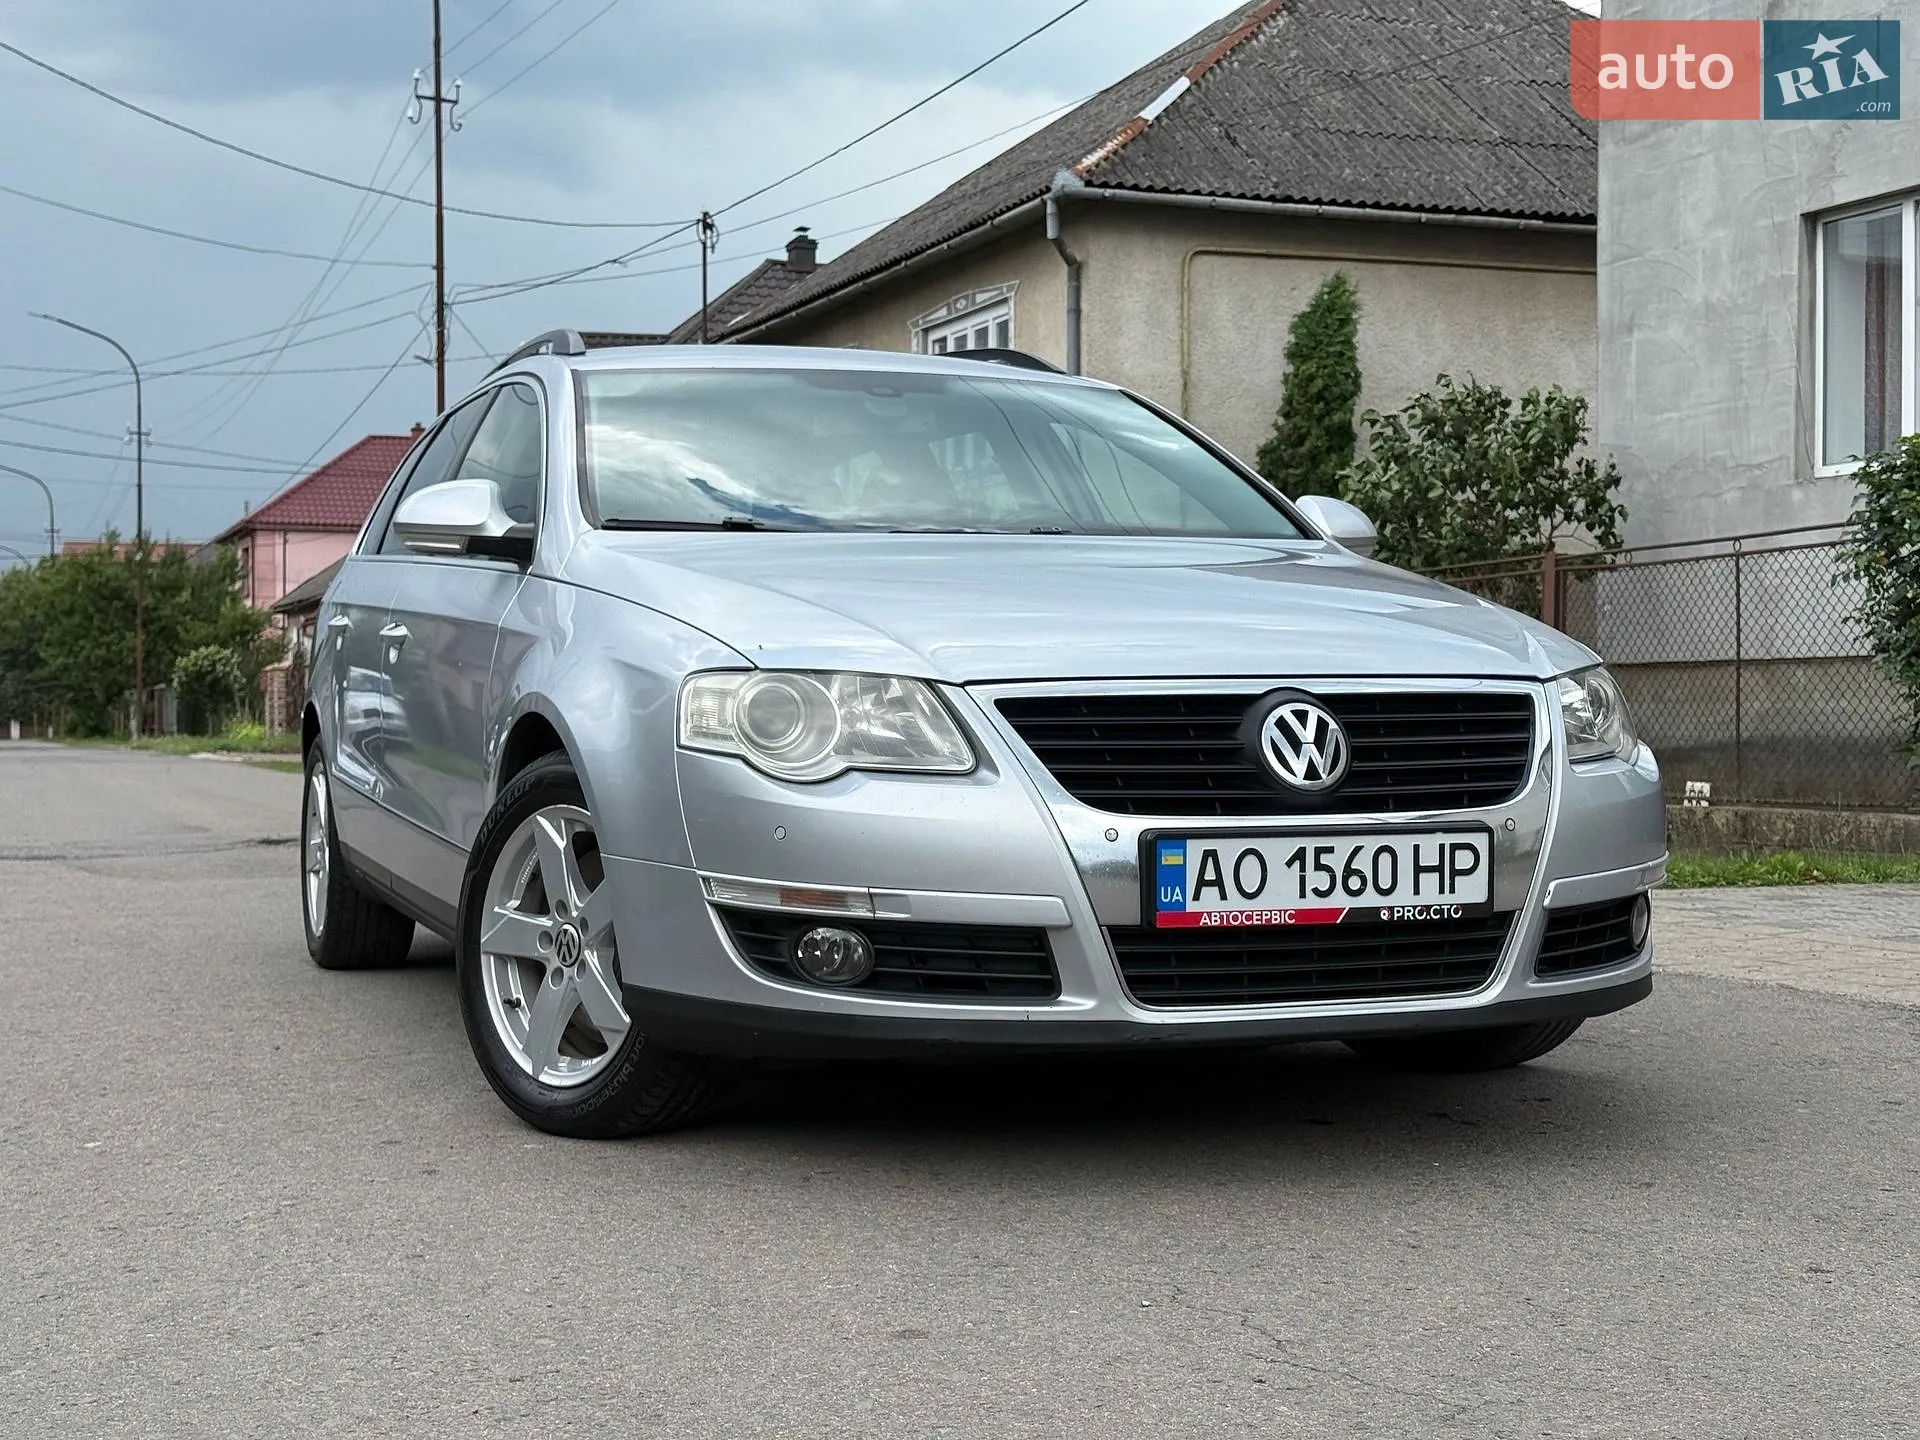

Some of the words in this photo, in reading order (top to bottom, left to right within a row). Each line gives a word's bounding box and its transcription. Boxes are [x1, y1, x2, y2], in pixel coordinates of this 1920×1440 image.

[480, 776, 536, 847] DUNLOP
[1192, 847, 1268, 902] AO
[1284, 844, 1398, 899] 1560
[1413, 842, 1480, 897] HP
[1161, 886, 1184, 903] UA
[1199, 910, 1296, 926] АВТОСЕРВІС
